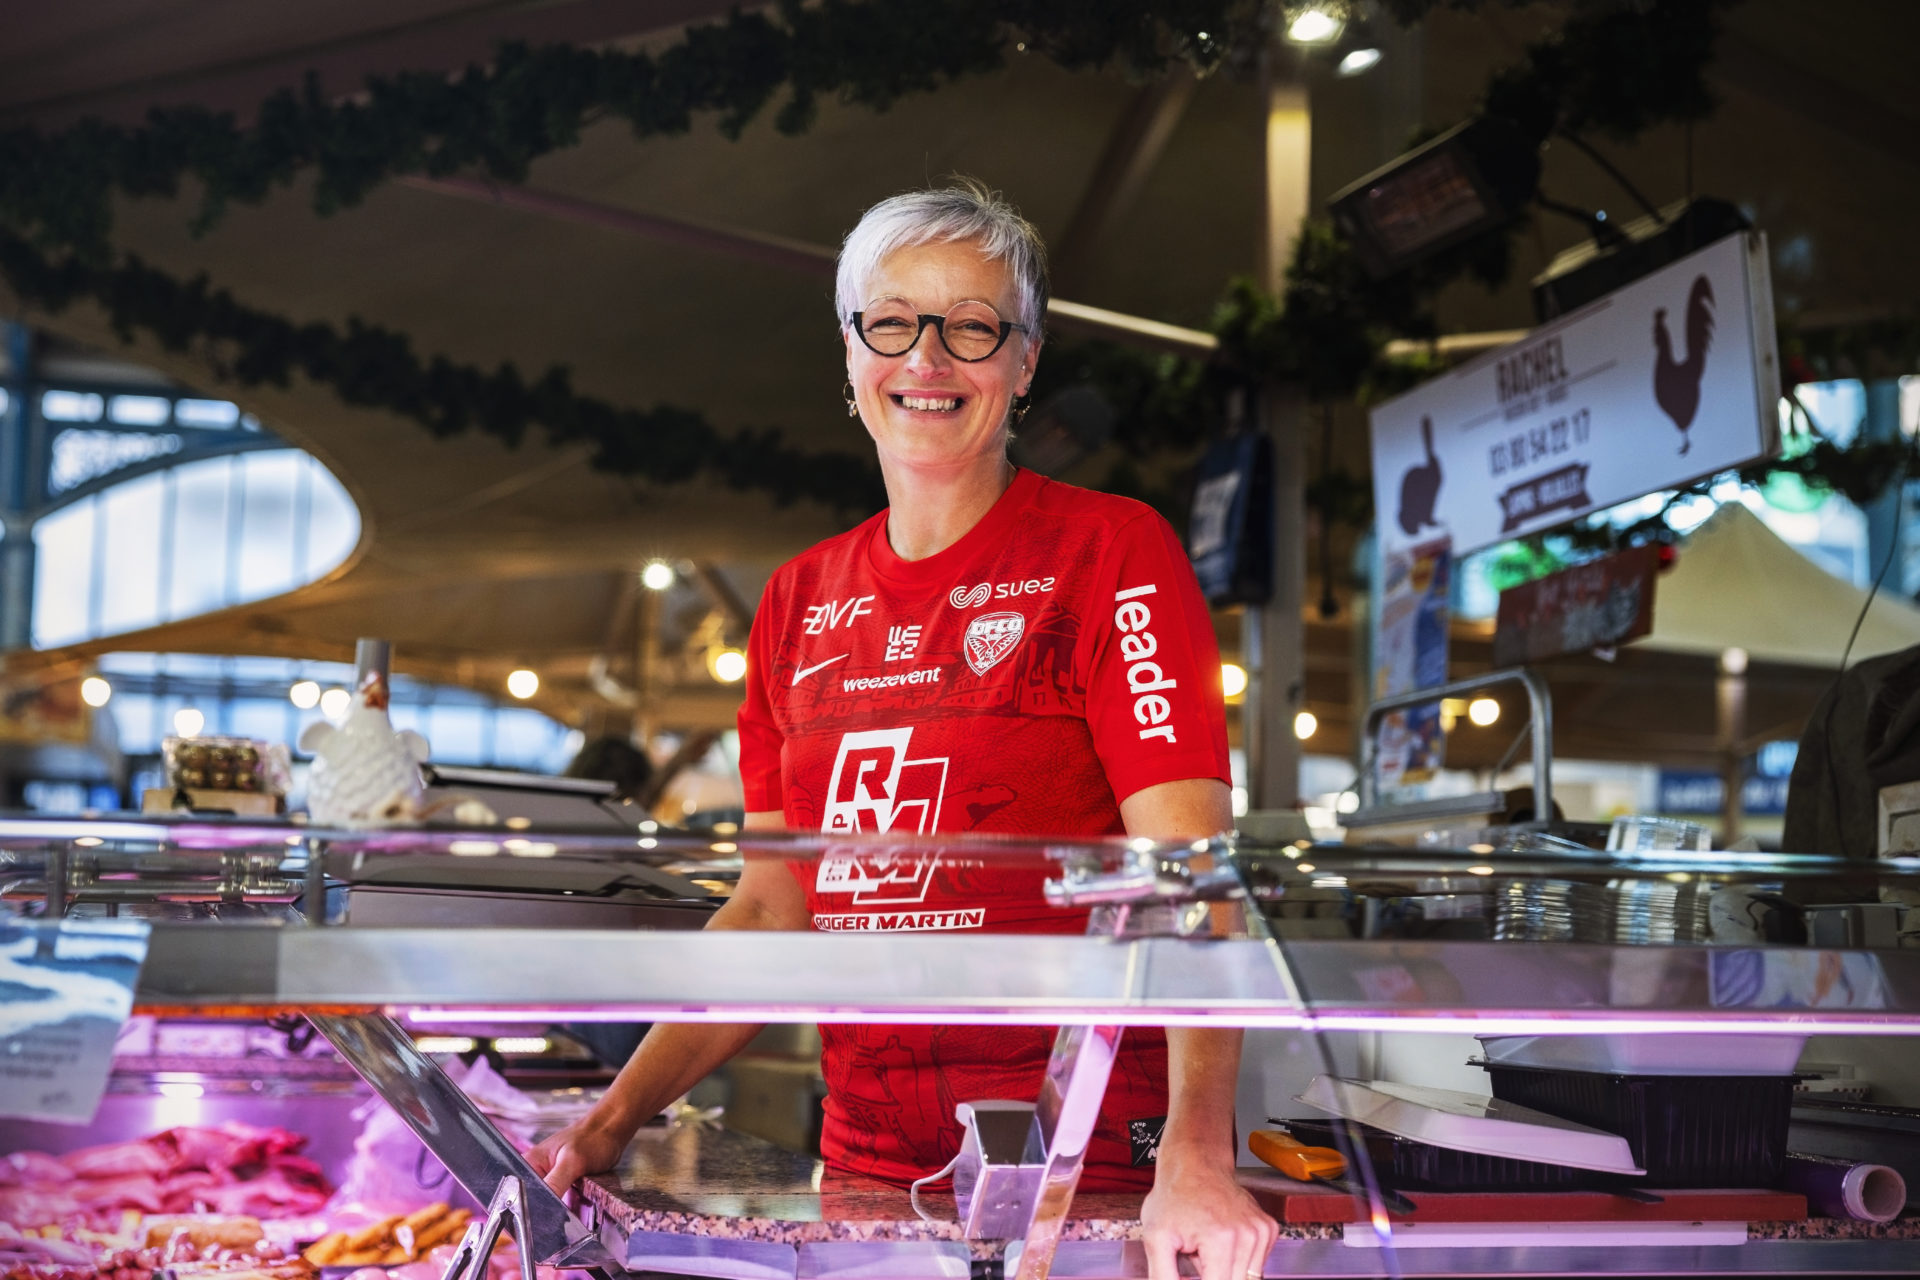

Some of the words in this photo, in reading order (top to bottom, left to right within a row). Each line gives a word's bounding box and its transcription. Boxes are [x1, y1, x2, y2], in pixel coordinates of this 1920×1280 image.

[1496, 335, 1568, 404] RACHEL
[1551, 416, 1569, 453] 22
[1572, 406, 1590, 444] 17
[843, 667, 942, 693] weezevent
[1115, 584, 1177, 743] leader
[816, 916, 870, 930] ROGER
[876, 911, 981, 930] MARTIN
